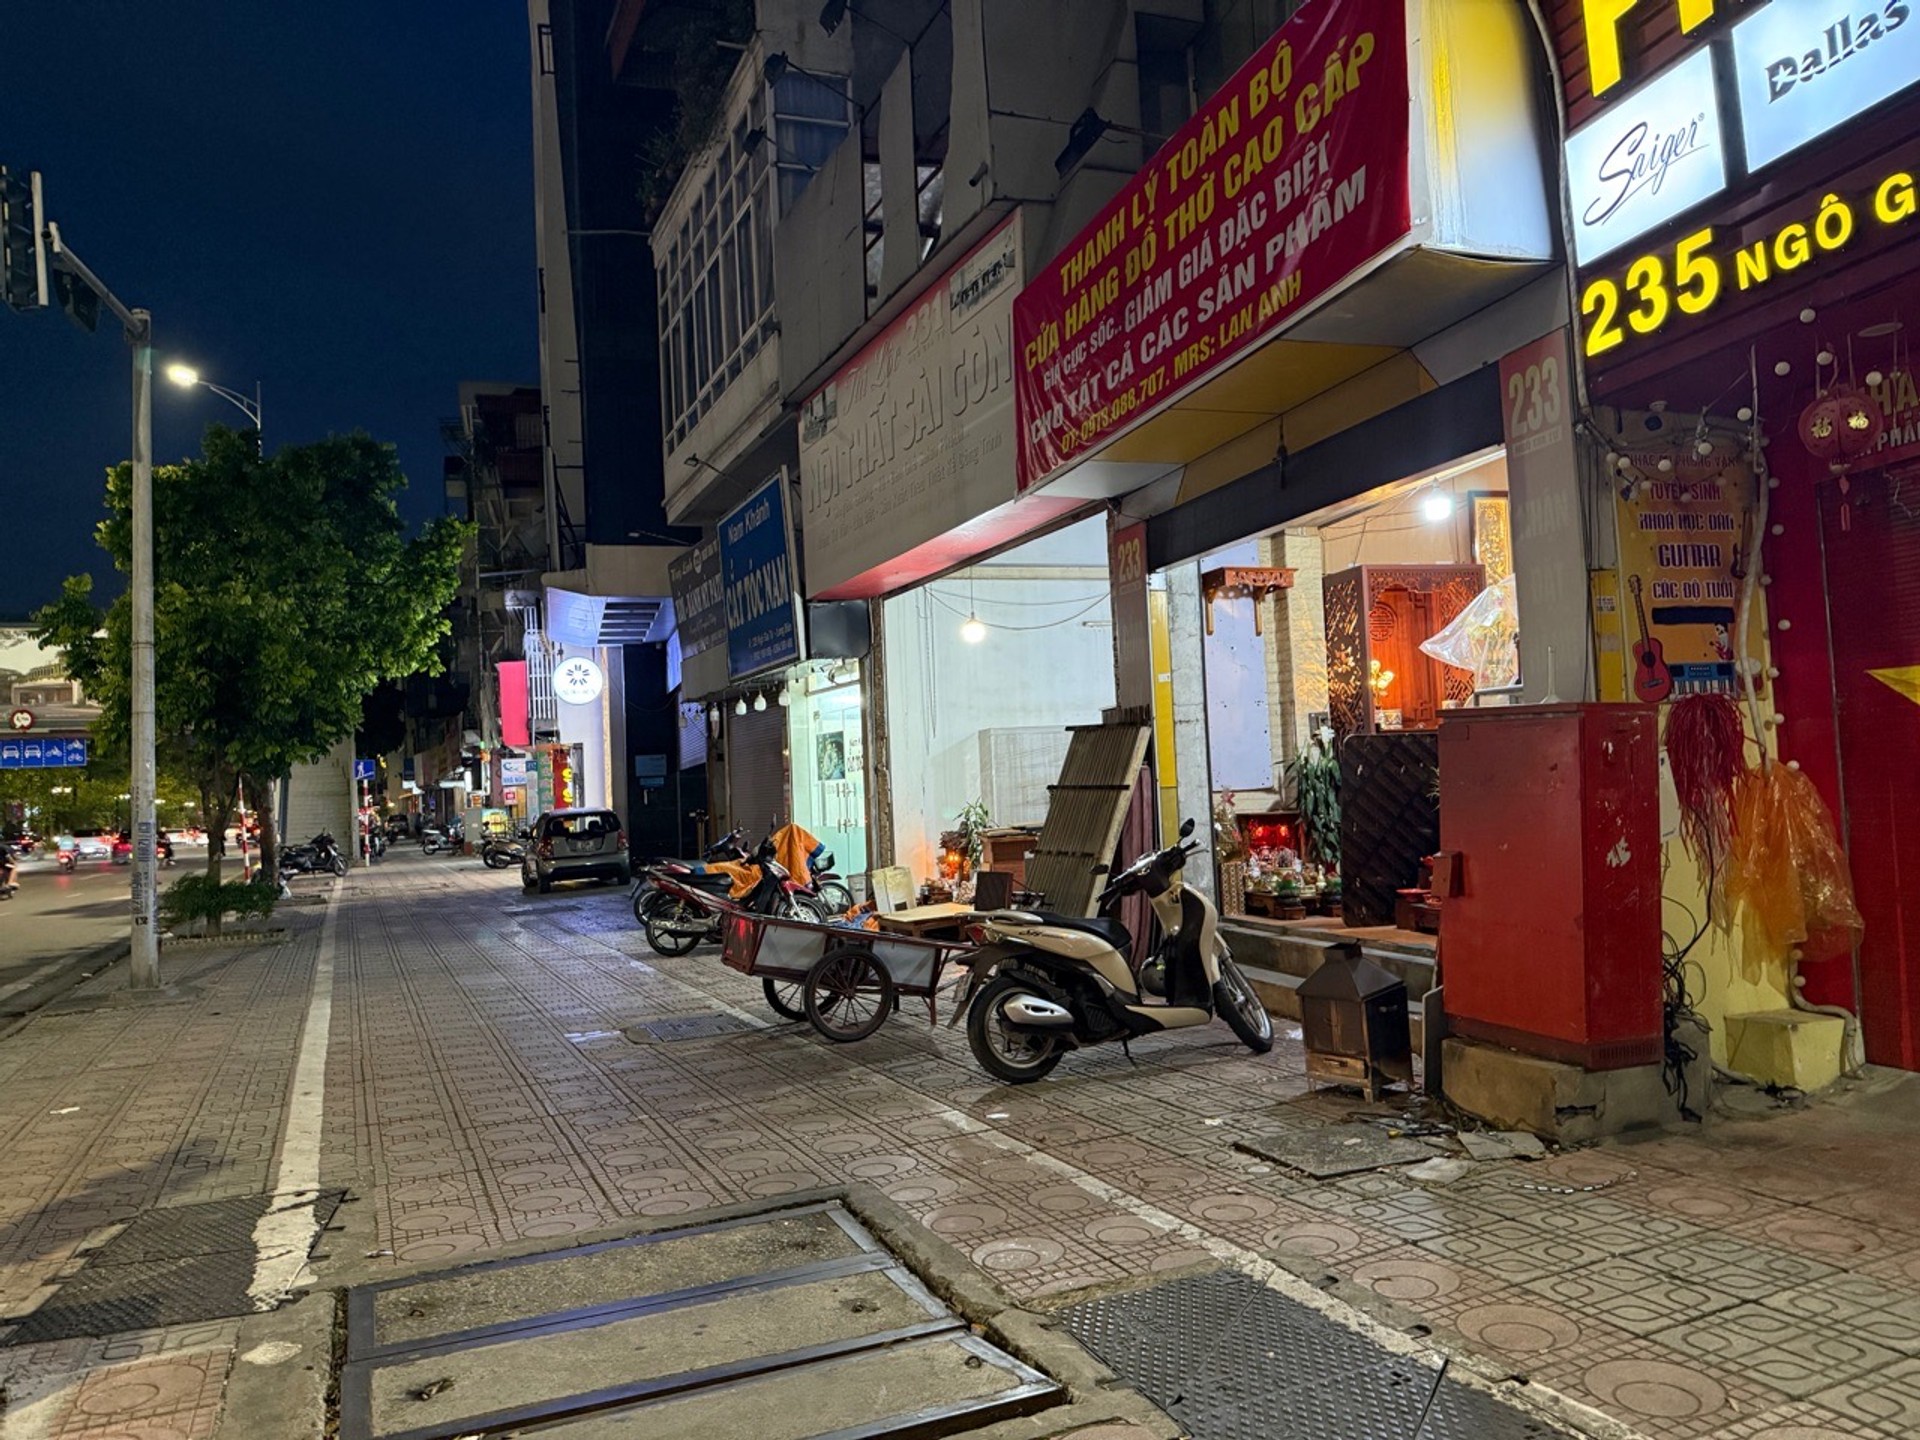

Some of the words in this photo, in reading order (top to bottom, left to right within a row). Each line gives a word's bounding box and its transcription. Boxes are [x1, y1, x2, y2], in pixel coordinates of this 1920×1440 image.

[1764, 0, 1910, 104] Dallas
[1025, 321, 1059, 372] CỬA
[1064, 266, 1119, 341] HÀNG
[1125, 218, 1157, 287] ĐỒ
[1164, 171, 1215, 251] THỜ
[1224, 115, 1283, 199] CAO
[1295, 32, 1375, 134] CẤP
[1060, 207, 1125, 296] THANH
[1132, 168, 1159, 230] LÝ
[1166, 95, 1239, 194] TOÀN
[1249, 39, 1292, 120] BỘ
[1124, 268, 1172, 333] GIẢM
[1179, 229, 1214, 289] GIÁ
[1219, 191, 1267, 257] ĐẶC
[1274, 131, 1330, 213] BIỆT
[1030, 402, 1064, 444] CHO
[1068, 370, 1101, 418] TẤT
[1106, 340, 1135, 391] CẢ
[1140, 306, 1189, 365] CÁC
[1197, 253, 1255, 323] SẢN
[1266, 164, 1366, 275] PHẨM
[1581, 227, 1720, 357] 235
[1735, 193, 1852, 290] NGÔ
[905, 291, 945, 356] 231
[1174, 334, 1215, 380] MRS:
[1219, 303, 1253, 349] LAN
[1258, 270, 1301, 323] ANH
[806, 444, 840, 518] NỘI
[841, 392, 897, 489] THẤT
[903, 366, 943, 450] SÀI
[952, 313, 1012, 417] GÒN
[1509, 356, 1560, 438] 233
[745, 498, 771, 534] Khánh
[1679, 513, 1704, 533] HỌC
[1691, 482, 1721, 500] SINH
[726, 558, 745, 632] CẮT
[744, 557, 764, 623] TÓC
[763, 554, 789, 613] NAM
[1118, 537, 1141, 583] 233
[1653, 579, 1679, 599] CÁC
[1683, 579, 1701, 601] ĐỘ
[1706, 577, 1734, 598] TUỔI
[1658, 543, 1721, 567] GUITAR
